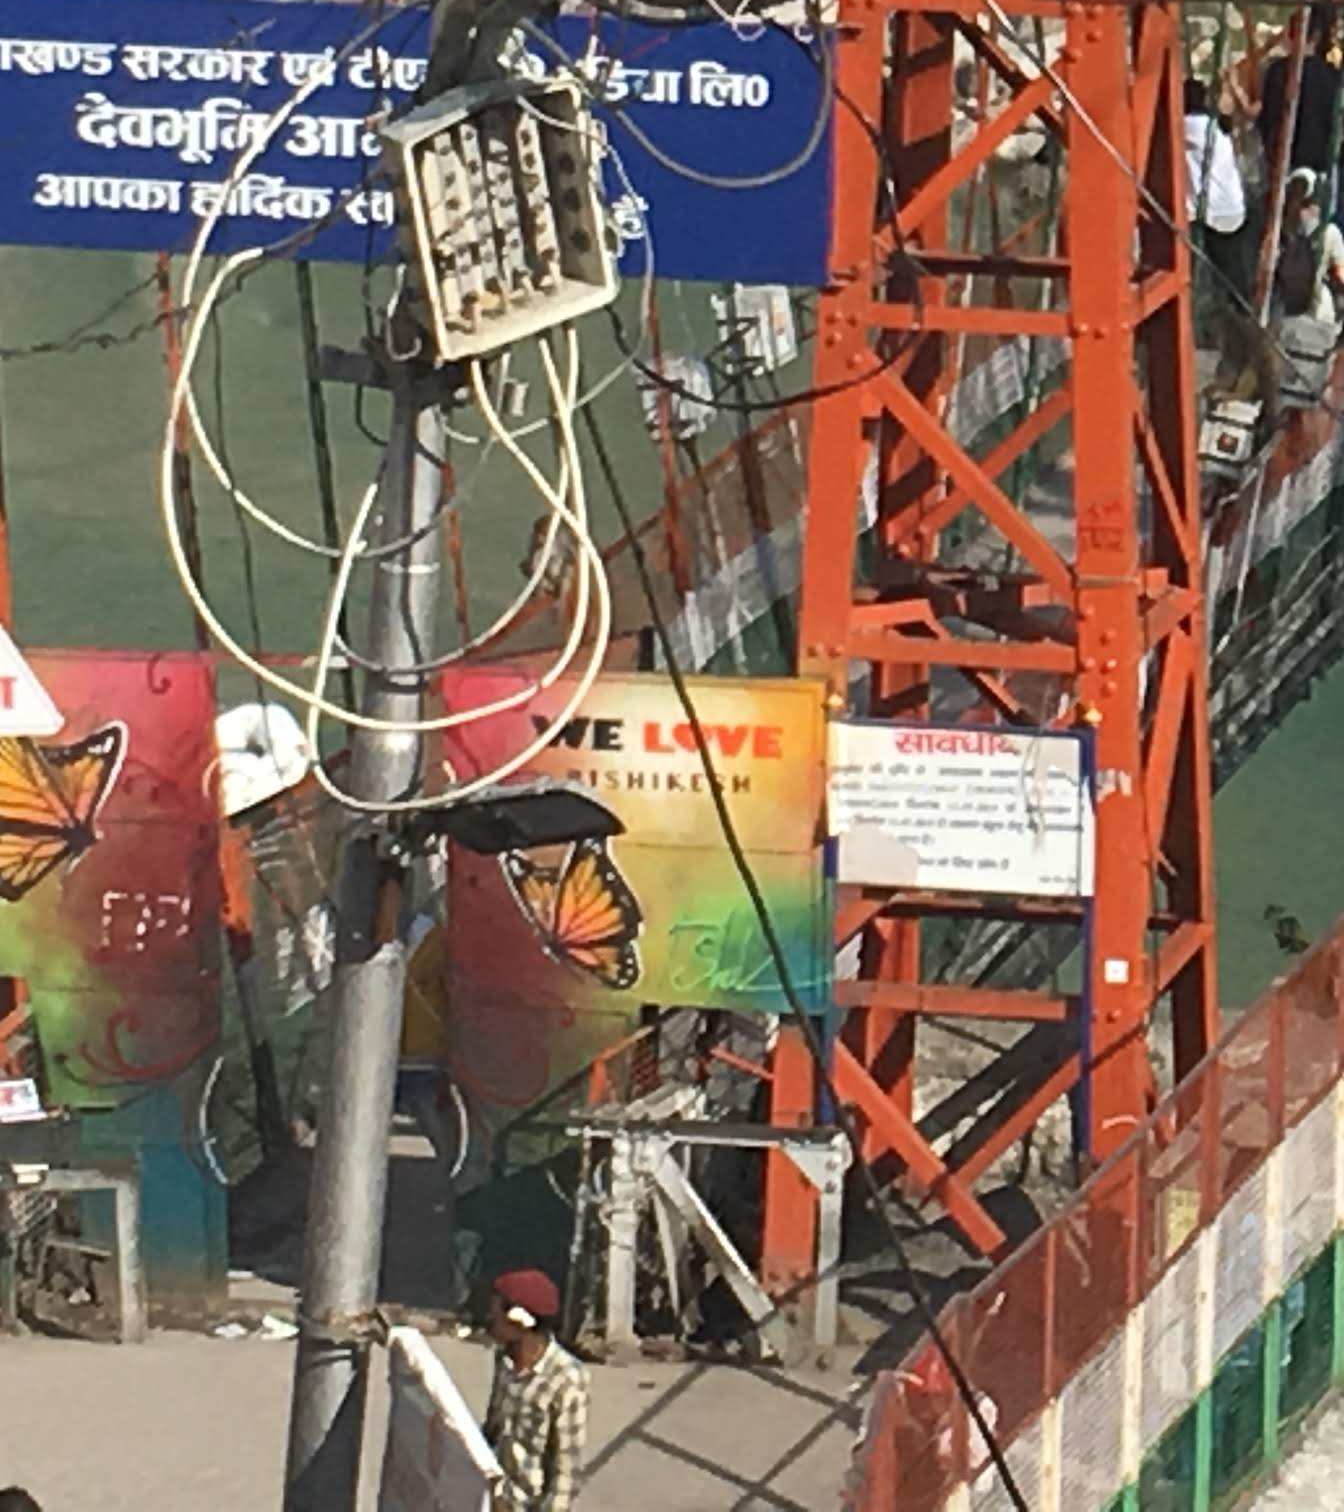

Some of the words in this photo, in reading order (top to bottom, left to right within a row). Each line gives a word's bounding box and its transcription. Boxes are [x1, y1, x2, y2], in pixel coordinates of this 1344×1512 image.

[122, 43, 275, 86] सरकार
[34, 172, 183, 213] आपका
[531, 715, 624, 752] WE
[643, 721, 784, 759] LOVE
